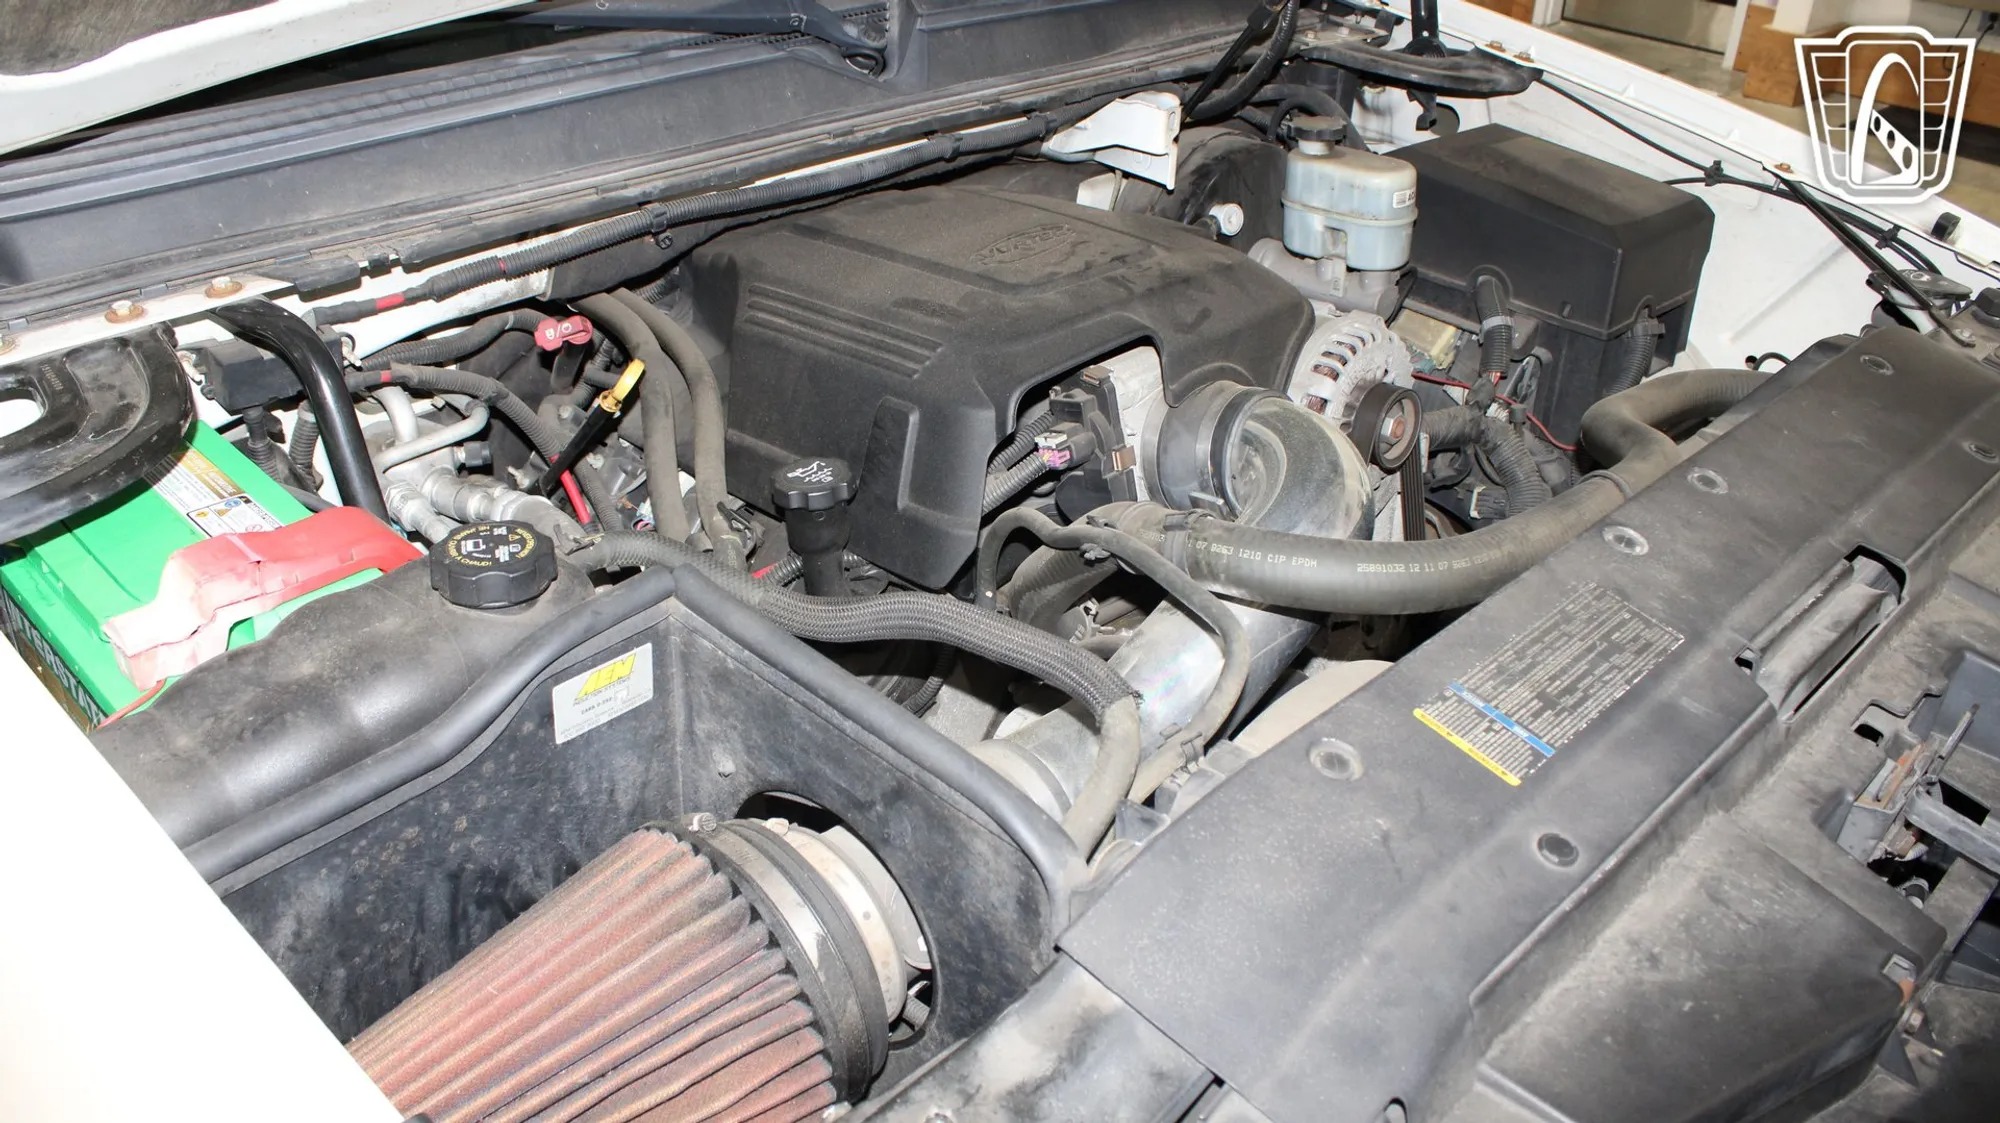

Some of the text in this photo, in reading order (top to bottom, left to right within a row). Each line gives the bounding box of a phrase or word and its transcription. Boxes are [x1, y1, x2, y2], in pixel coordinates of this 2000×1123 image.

[1238, 548, 1262, 561] 1210
[1356, 562, 1406, 573] 25891032
[1409, 563, 1421, 573] 12
[1424, 562, 1435, 573] 11
[1437, 561, 1449, 571] 07
[576, 652, 637, 701] AEM
